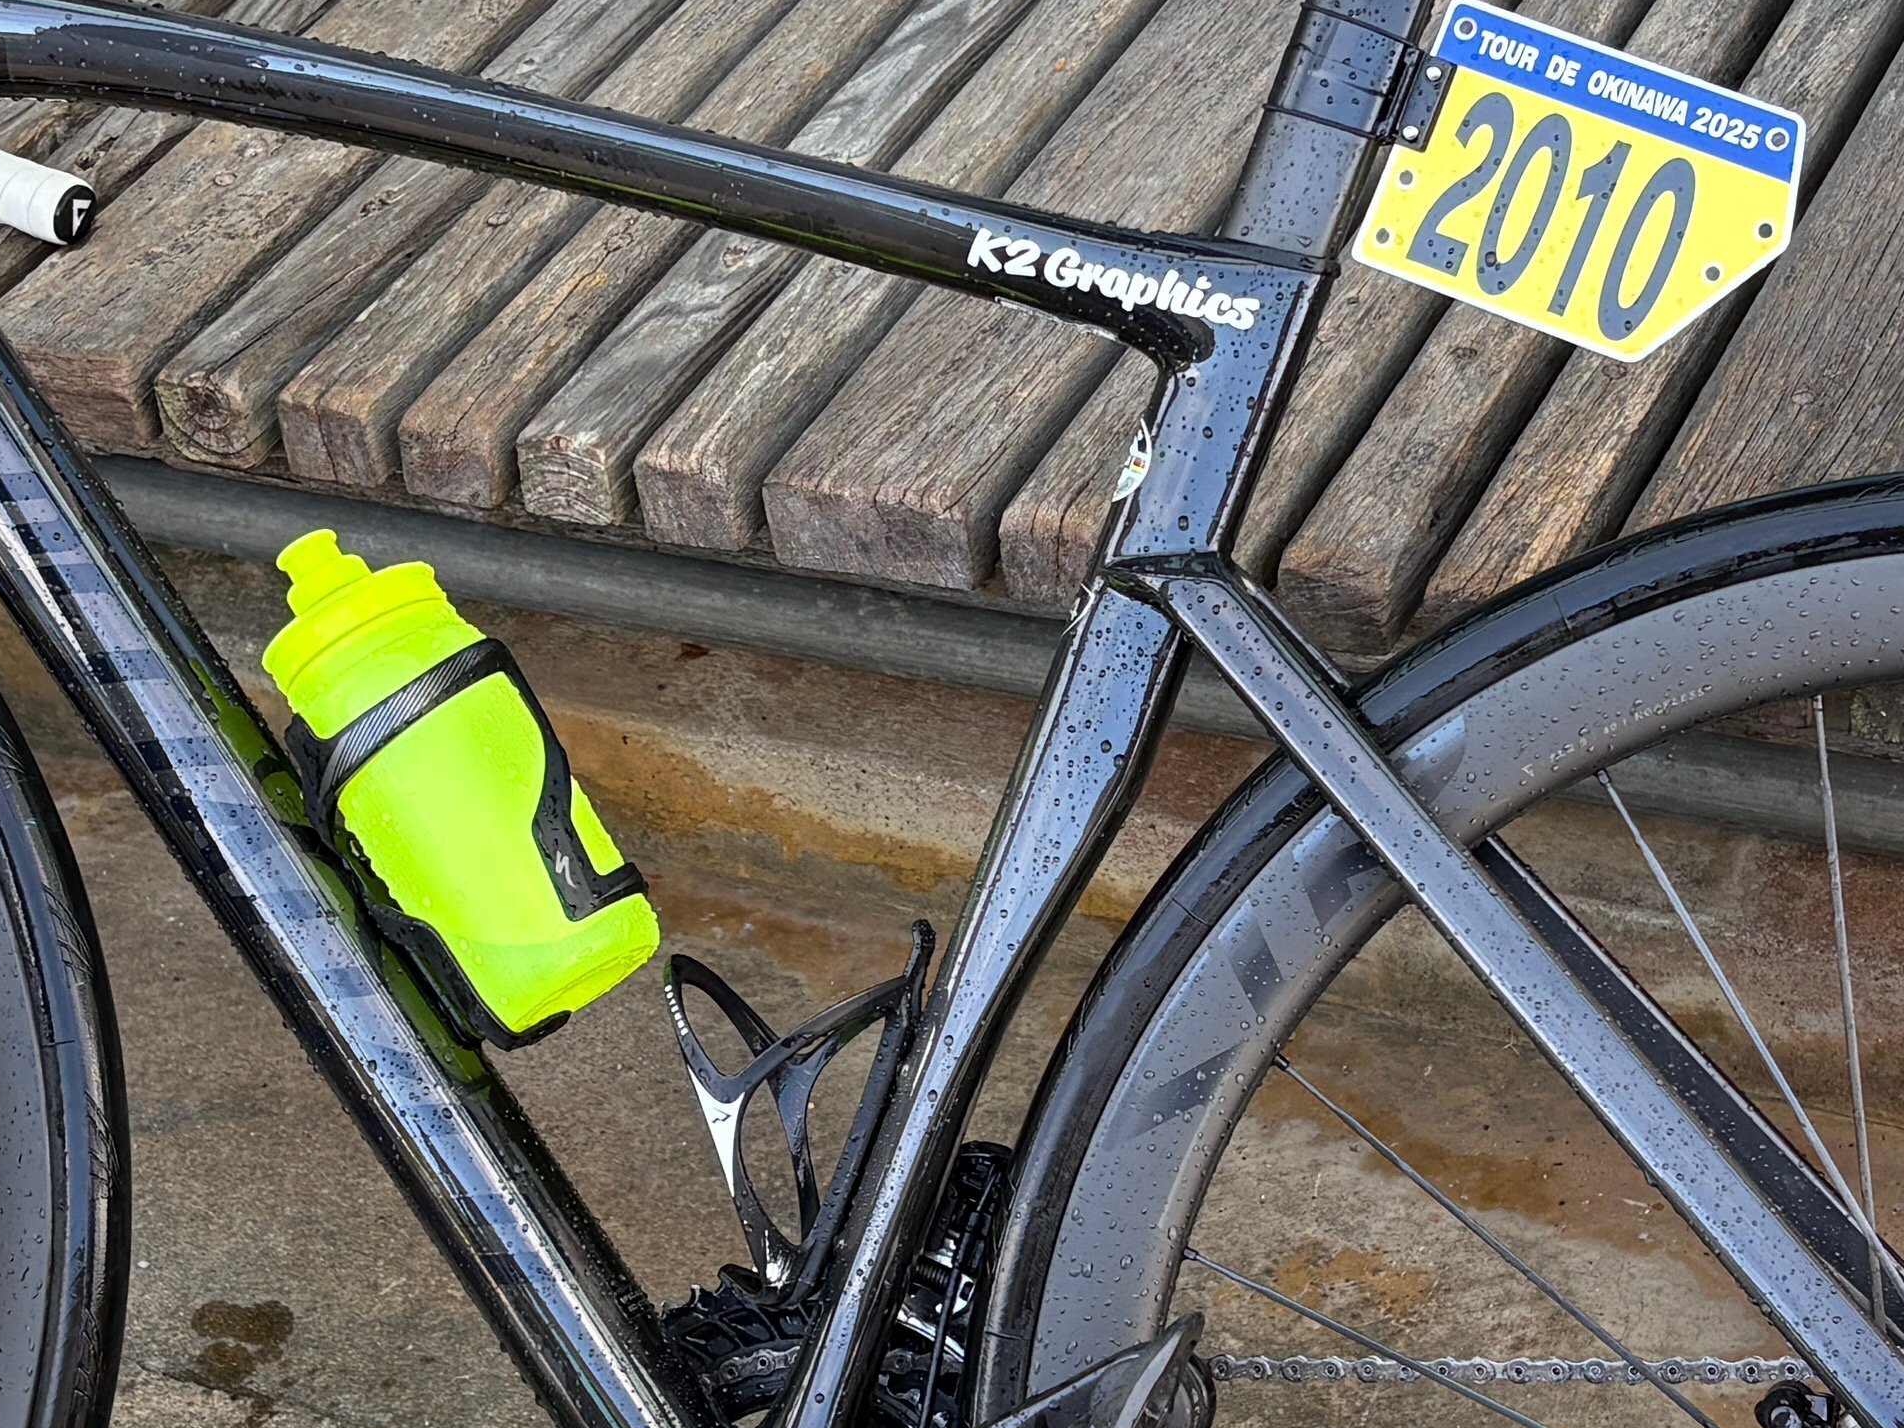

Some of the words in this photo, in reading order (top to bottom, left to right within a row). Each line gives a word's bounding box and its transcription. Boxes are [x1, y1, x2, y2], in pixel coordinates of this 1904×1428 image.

[1479, 30, 1539, 73] TOUR
[1545, 56, 1581, 87] DE
[1587, 70, 1688, 126] OKINAWA
[1690, 107, 1763, 150] 2025
[1406, 92, 1696, 341] 2010
[967, 227, 1041, 278] K2
[1043, 247, 1261, 331] Graphics
